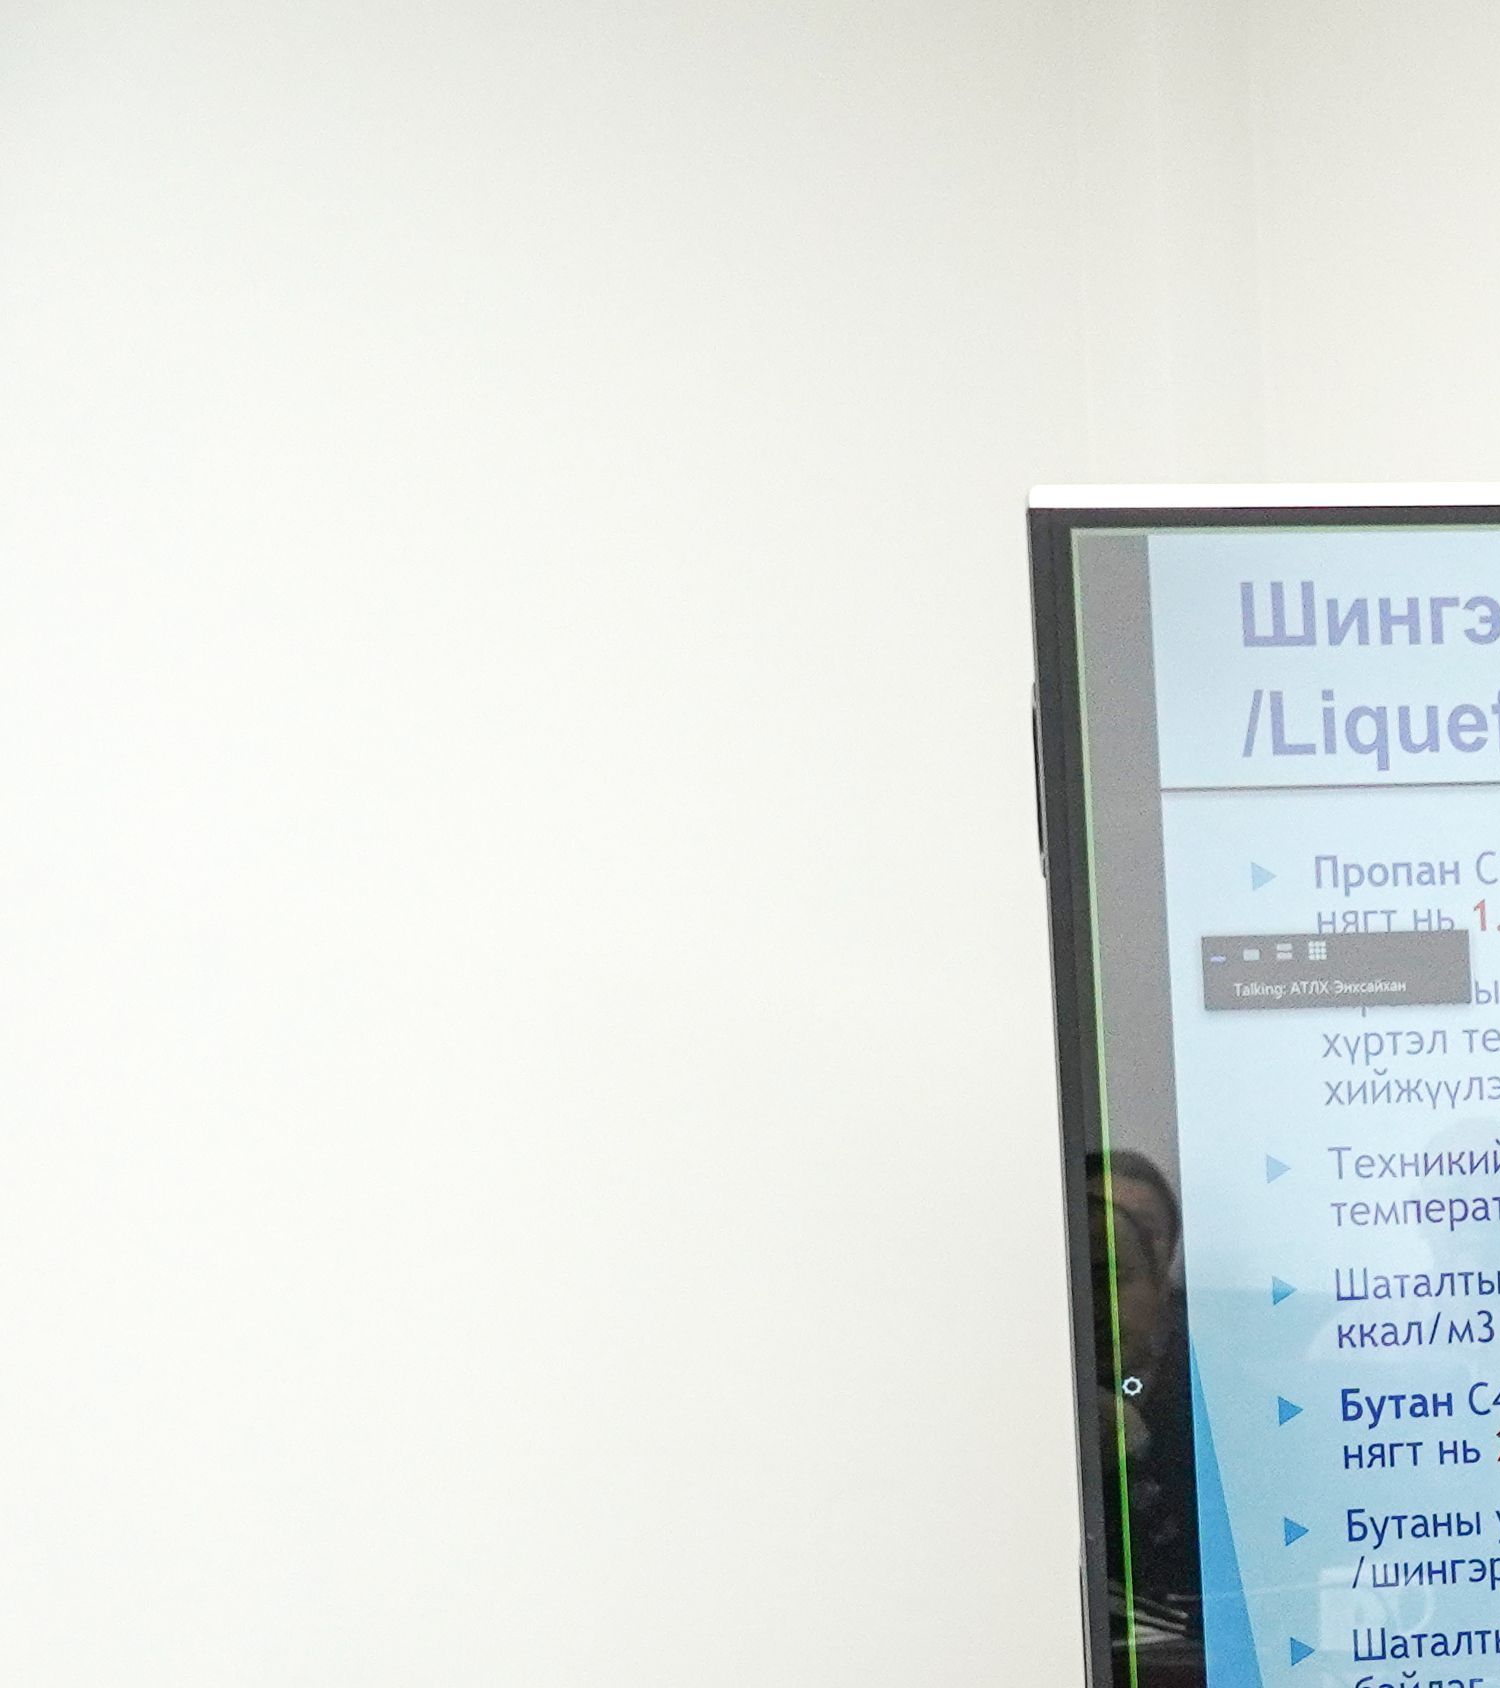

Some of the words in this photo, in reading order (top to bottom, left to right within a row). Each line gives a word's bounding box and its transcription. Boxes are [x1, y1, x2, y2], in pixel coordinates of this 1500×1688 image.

[1314, 855, 1461, 896] Пропан
[1317, 907, 1396, 933] нягт
[1413, 907, 1455, 931] нь
[1233, 982, 1288, 999] Talking:
[1322, 1030, 1448, 1065] хүртэл
[1337, 1310, 1496, 1348] ккал/м3
[1341, 1388, 1454, 1430] Бутан
[1343, 1441, 1423, 1470] нягт
[1439, 1438, 1481, 1464] нь
[1346, 1507, 1481, 1550] Бутаны
